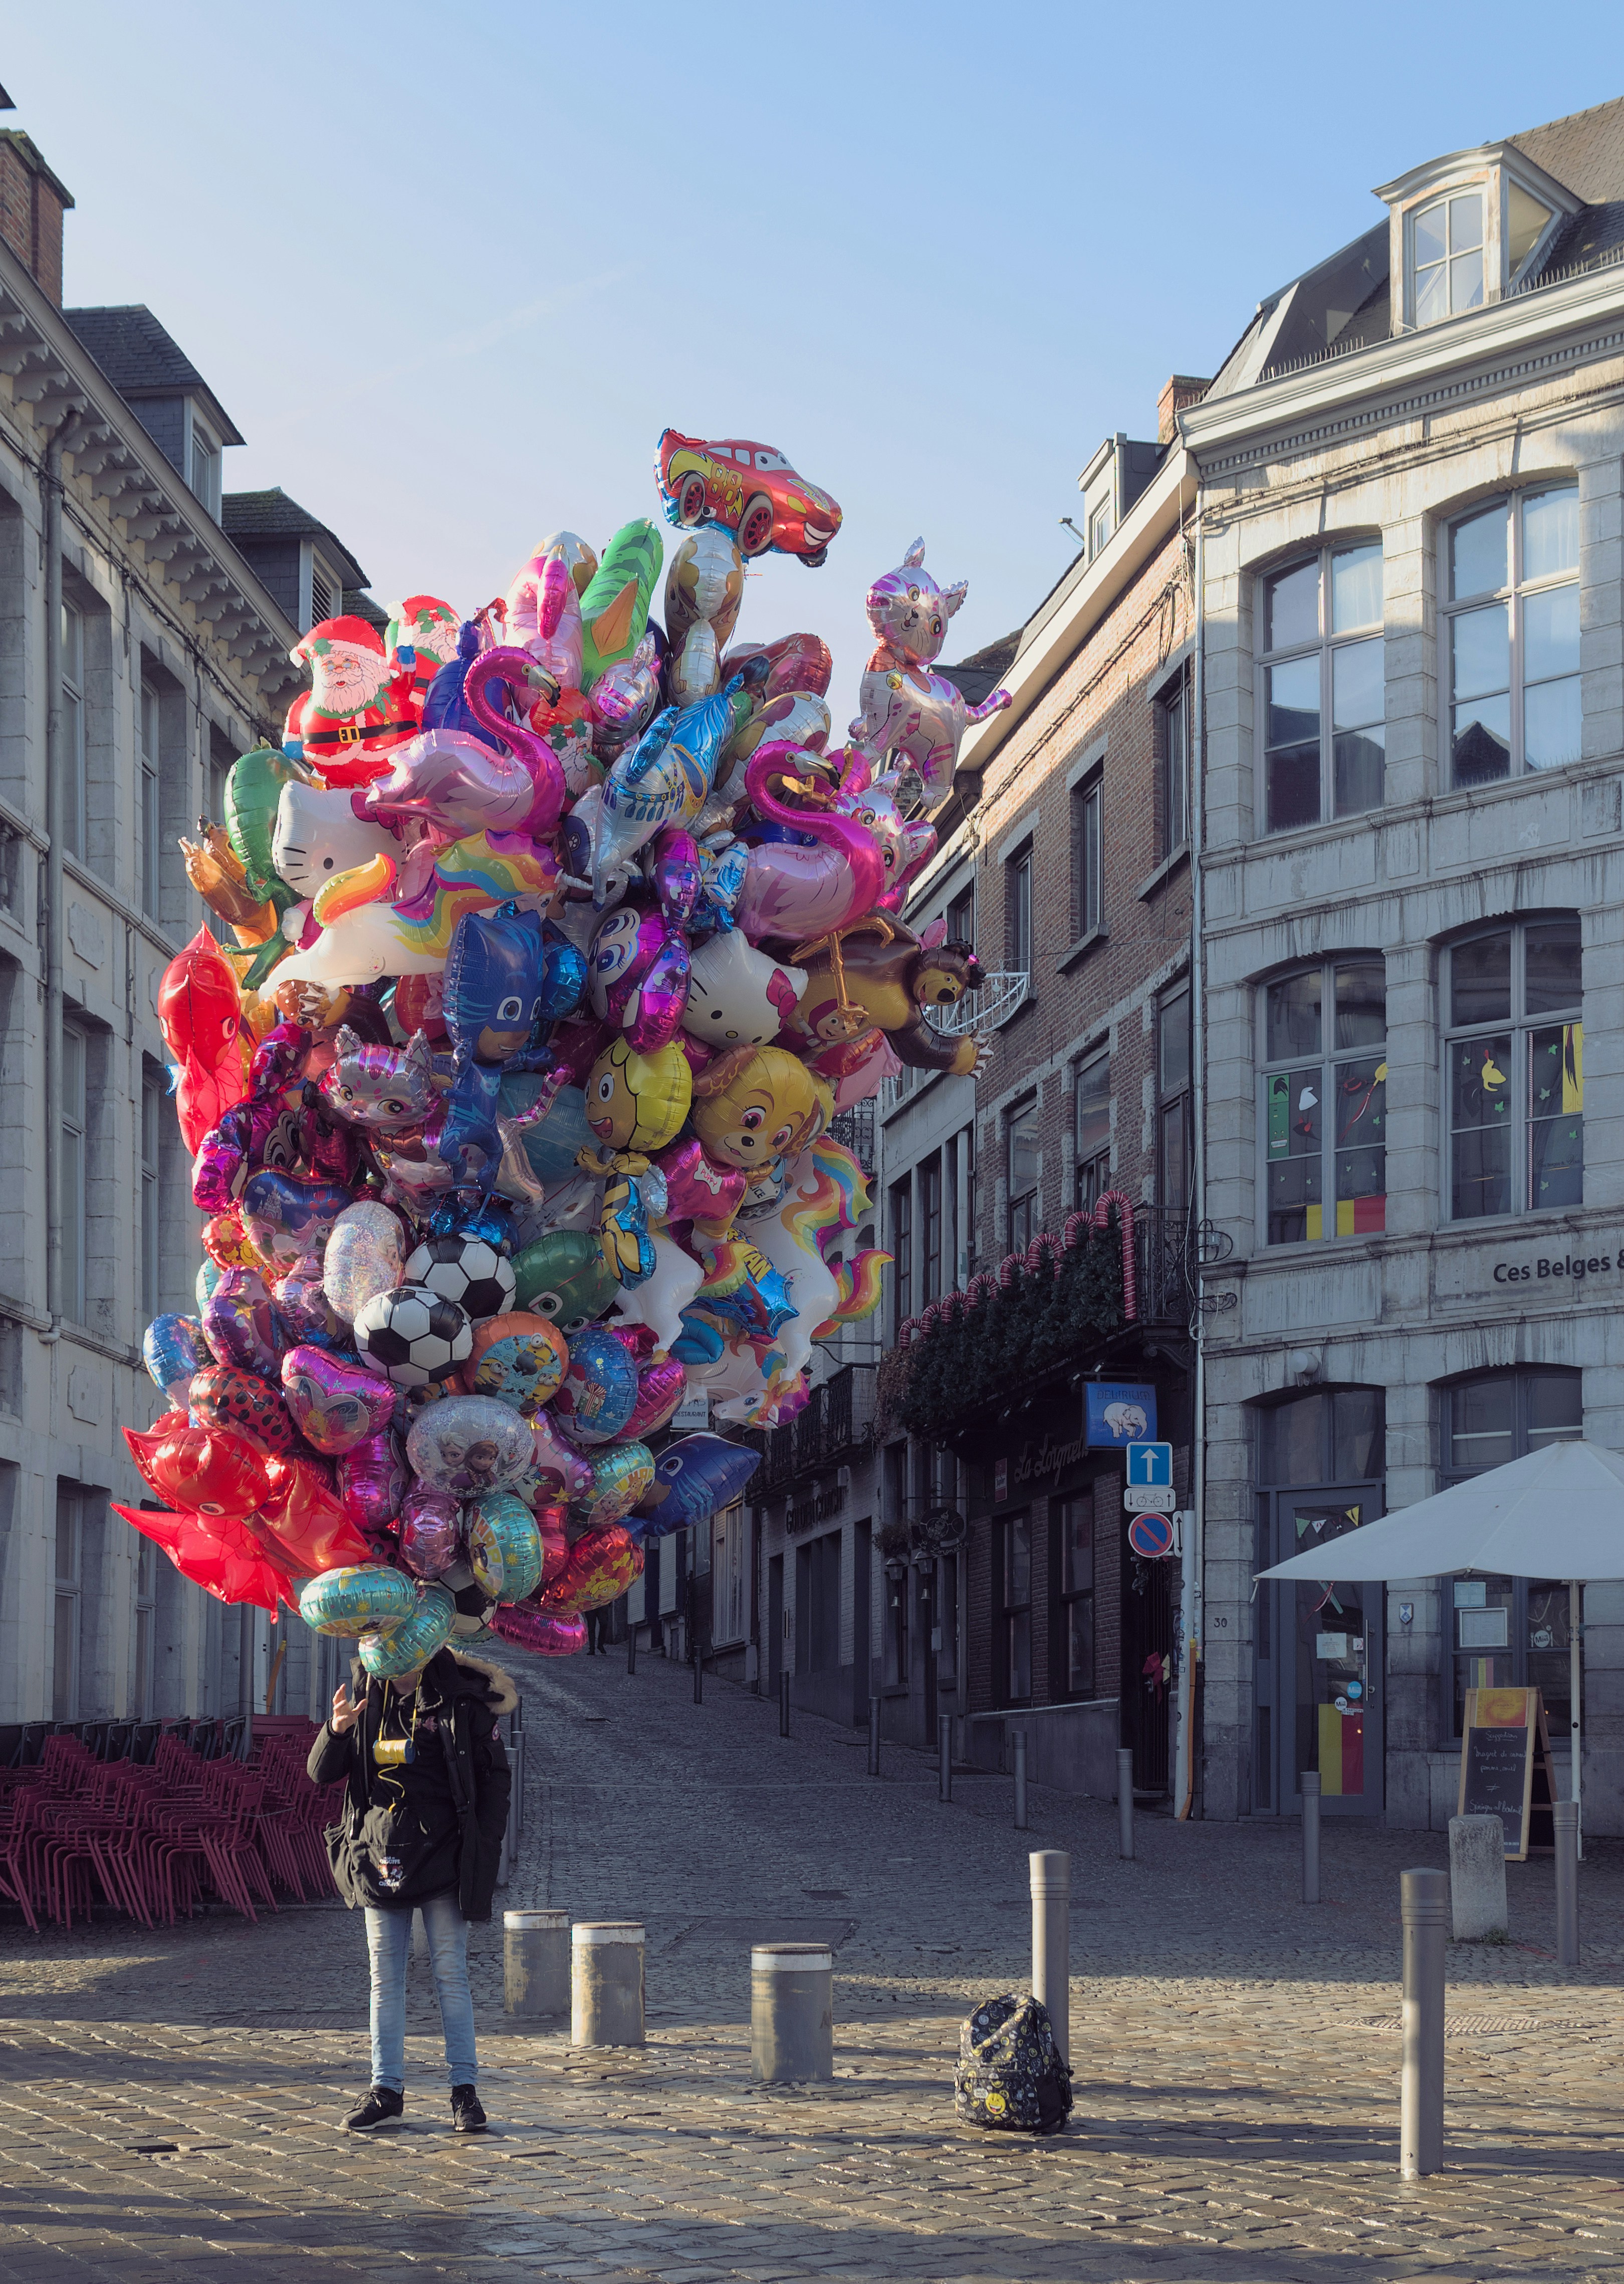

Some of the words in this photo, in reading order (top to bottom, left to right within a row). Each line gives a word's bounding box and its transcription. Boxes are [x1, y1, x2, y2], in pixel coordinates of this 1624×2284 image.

[707, 462, 743, 507] 88
[701, 1168, 718, 1187] PUPPY
[1494, 1263, 1530, 1283] Ces
[1537, 1255, 1610, 1280] Belges
[1097, 1390, 1151, 1400] DELIRIUM
[1214, 1617, 1227, 1628] 30
